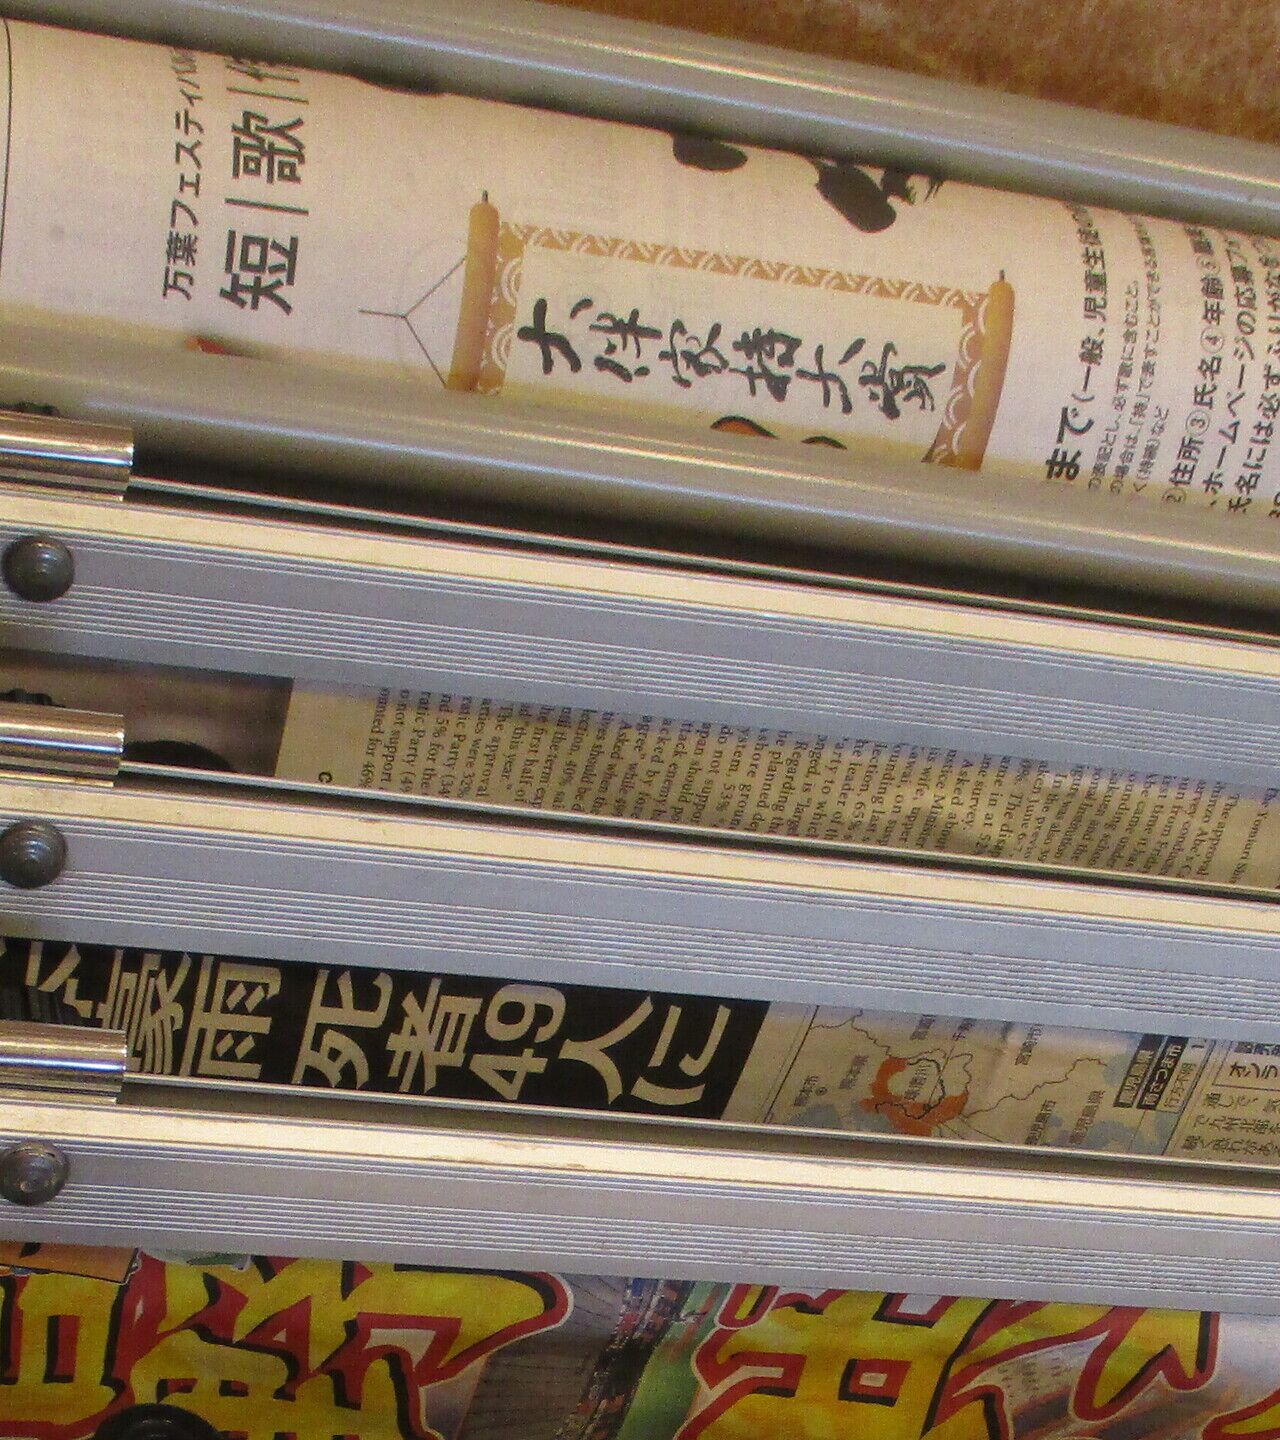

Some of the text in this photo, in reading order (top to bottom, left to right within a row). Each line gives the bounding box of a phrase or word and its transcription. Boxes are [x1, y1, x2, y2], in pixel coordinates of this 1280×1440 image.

[516, 296, 947, 420] 大伴家持大賞
[366, 738, 383, 759] for
[379, 703, 411, 784] not support
[404, 727, 425, 768] Party
[420, 717, 451, 789] 5% for the
[443, 733, 467, 771] Party
[466, 739, 484, 769] were
[519, 727, 549, 786] first half
[550, 731, 567, 751] the
[598, 720, 632, 793] Asked when
[708, 726, 733, 776] do not
[476, 736, 502, 798] approval
[574, 743, 603, 801] should be
[618, 763, 639, 794] while
[642, 769, 661, 787] by
[655, 763, 679, 806] enemy
[677, 760, 702, 804] should
[755, 751, 781, 809] planned
[772, 741, 809, 812] Regarding
[803, 782, 814, 793] is
[821, 779, 836, 795] to
[913, 767, 933, 801] wife,
[950, 759, 974, 806] Asked
[716, 784, 735, 812] 53%
[832, 762, 863, 825] leader of
[892, 794, 905, 814] on
[961, 781, 987, 831] survey.
[983, 793, 1003, 828] in at
[1004, 793, 1024, 820] The
[1220, 793, 1240, 819] The
[847, 802, 867, 831] 65%
[868, 811, 887, 833] last
[290, 967, 734, 1106] 死者49人に
[1144, 1043, 1183, 1107] 南さつま市
[1163, 1062, 1198, 1110] 行方不明
